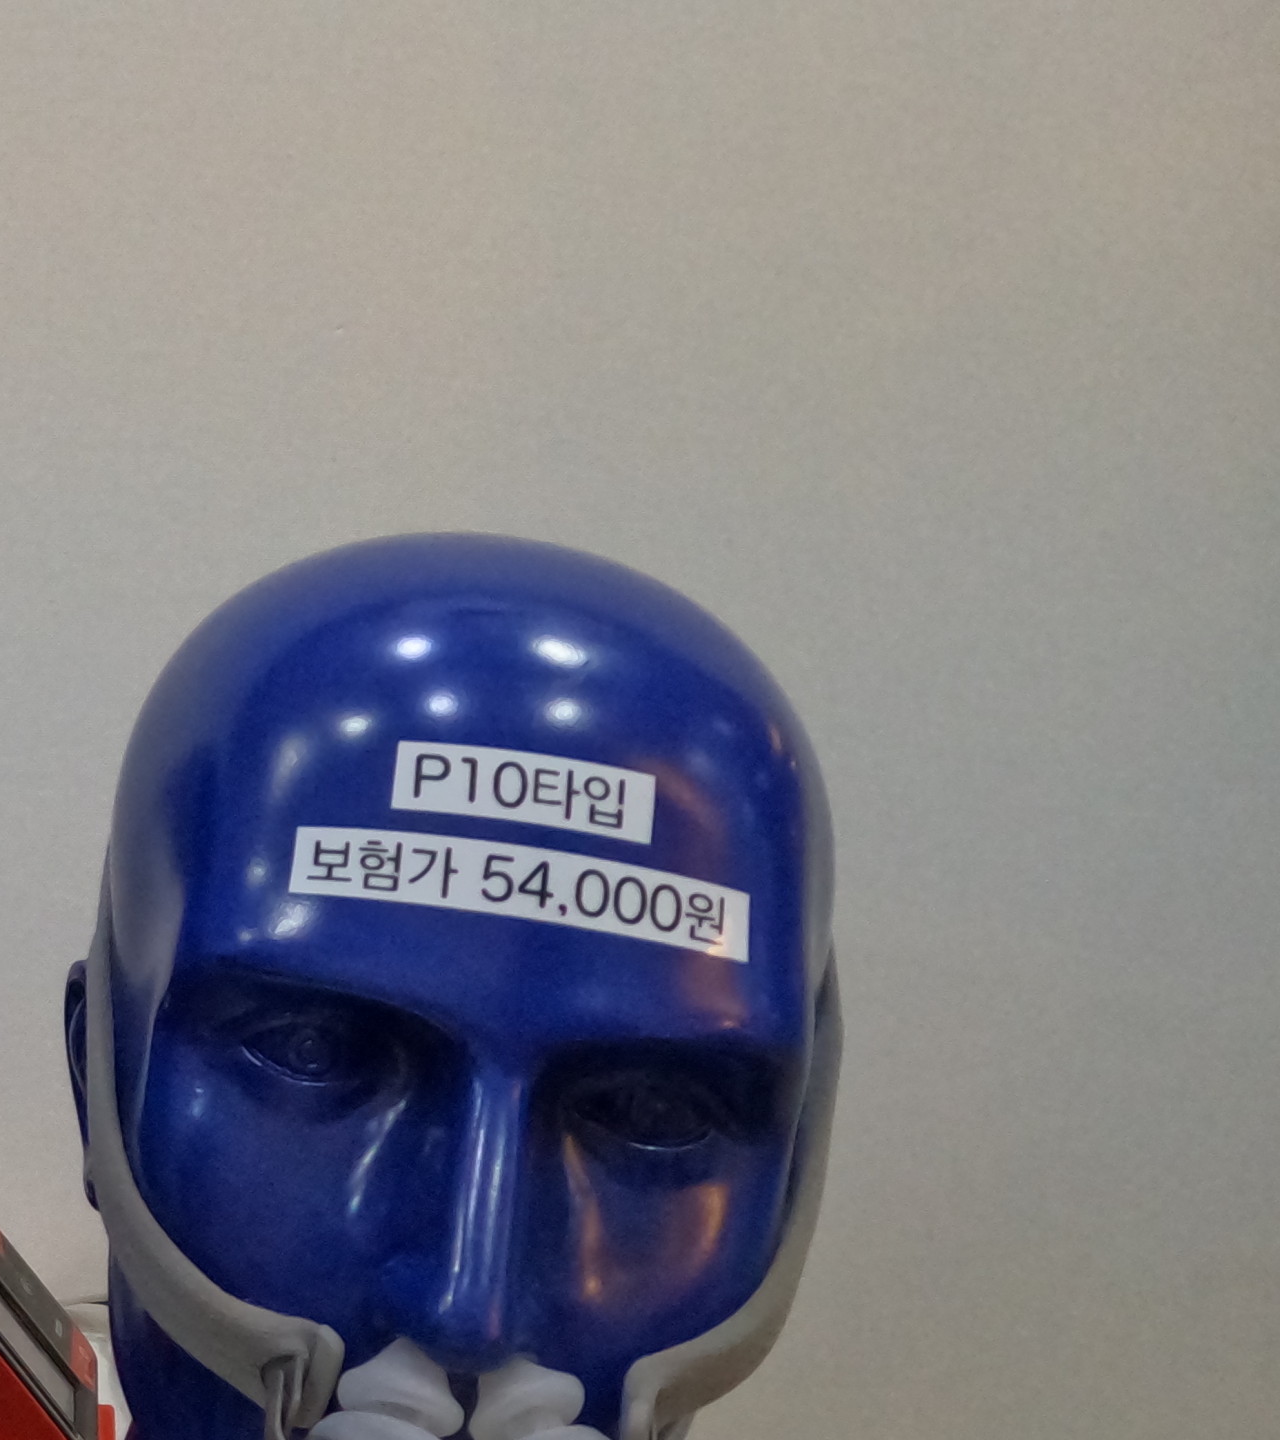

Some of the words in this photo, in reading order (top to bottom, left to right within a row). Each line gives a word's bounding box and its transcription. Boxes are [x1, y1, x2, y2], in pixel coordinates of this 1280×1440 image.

[412, 752, 626, 829] P10타입
[305, 839, 459, 899] 보험가
[479, 854, 726, 946] 54,000원
